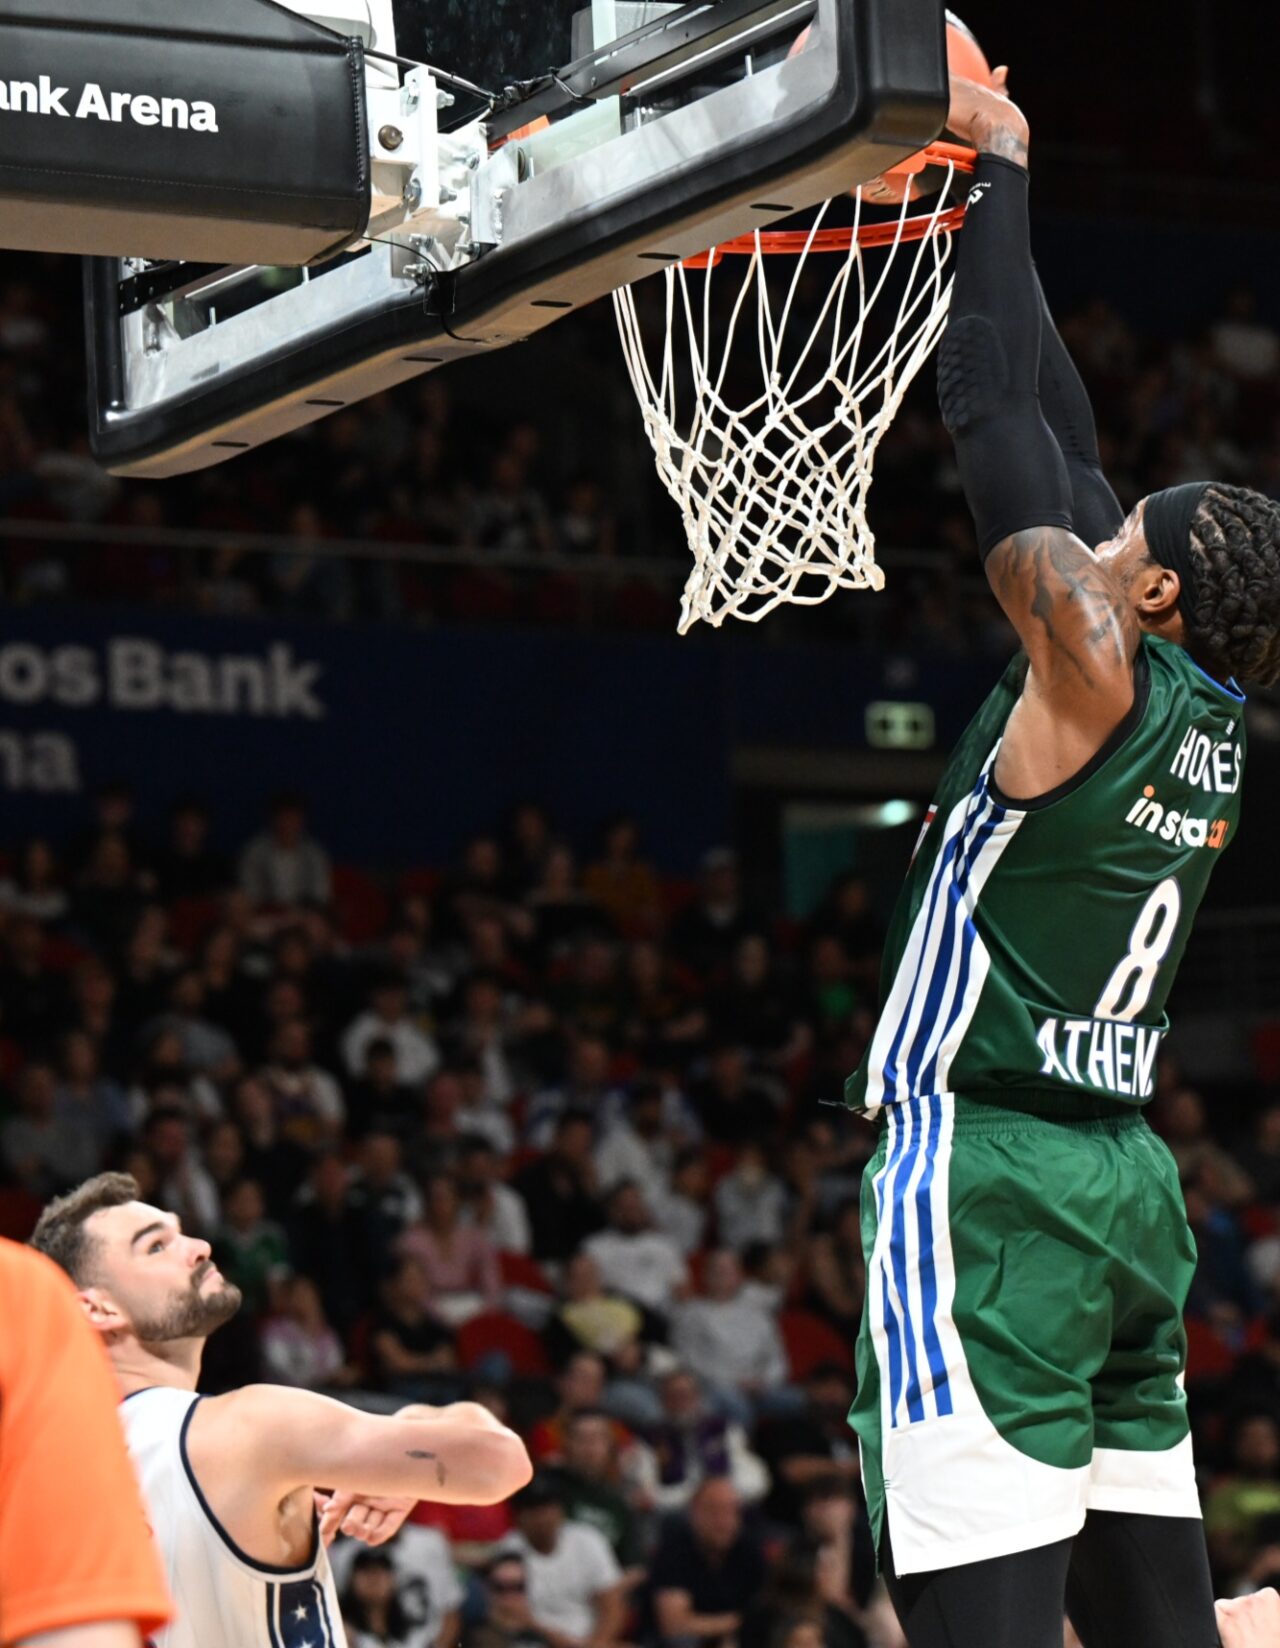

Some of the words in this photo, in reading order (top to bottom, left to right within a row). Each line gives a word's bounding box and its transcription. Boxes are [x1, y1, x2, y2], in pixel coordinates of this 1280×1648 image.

[75, 82, 219, 133] Arena
[1093, 875, 1181, 1023] 8
[1035, 1016, 1160, 1098] ATHEN
